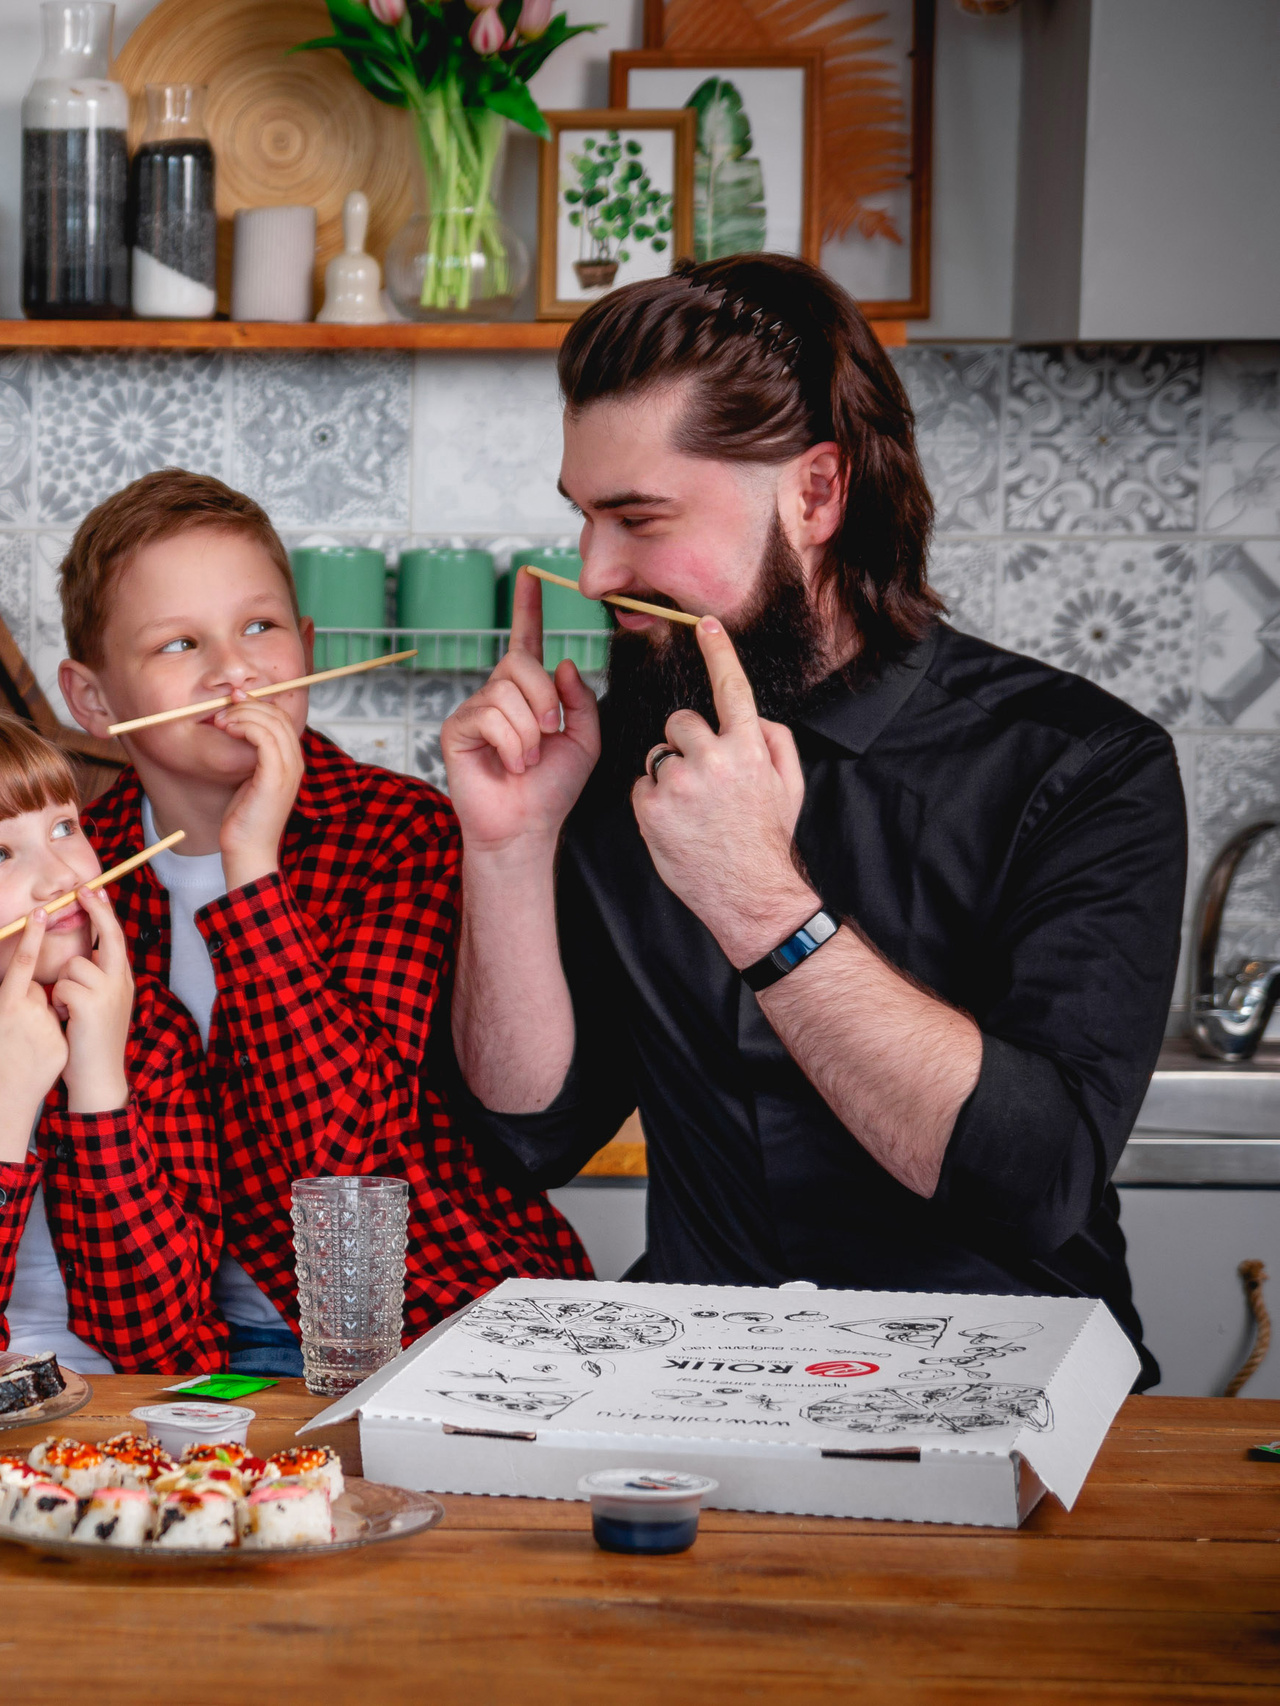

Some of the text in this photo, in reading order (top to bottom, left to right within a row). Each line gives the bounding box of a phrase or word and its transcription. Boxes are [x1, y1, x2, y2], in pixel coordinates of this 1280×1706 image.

[661, 1360, 794, 1374] ROLIK
[676, 1377, 756, 1386] аппетита!
[596, 1411, 791, 1426] www.rolik64.ru
